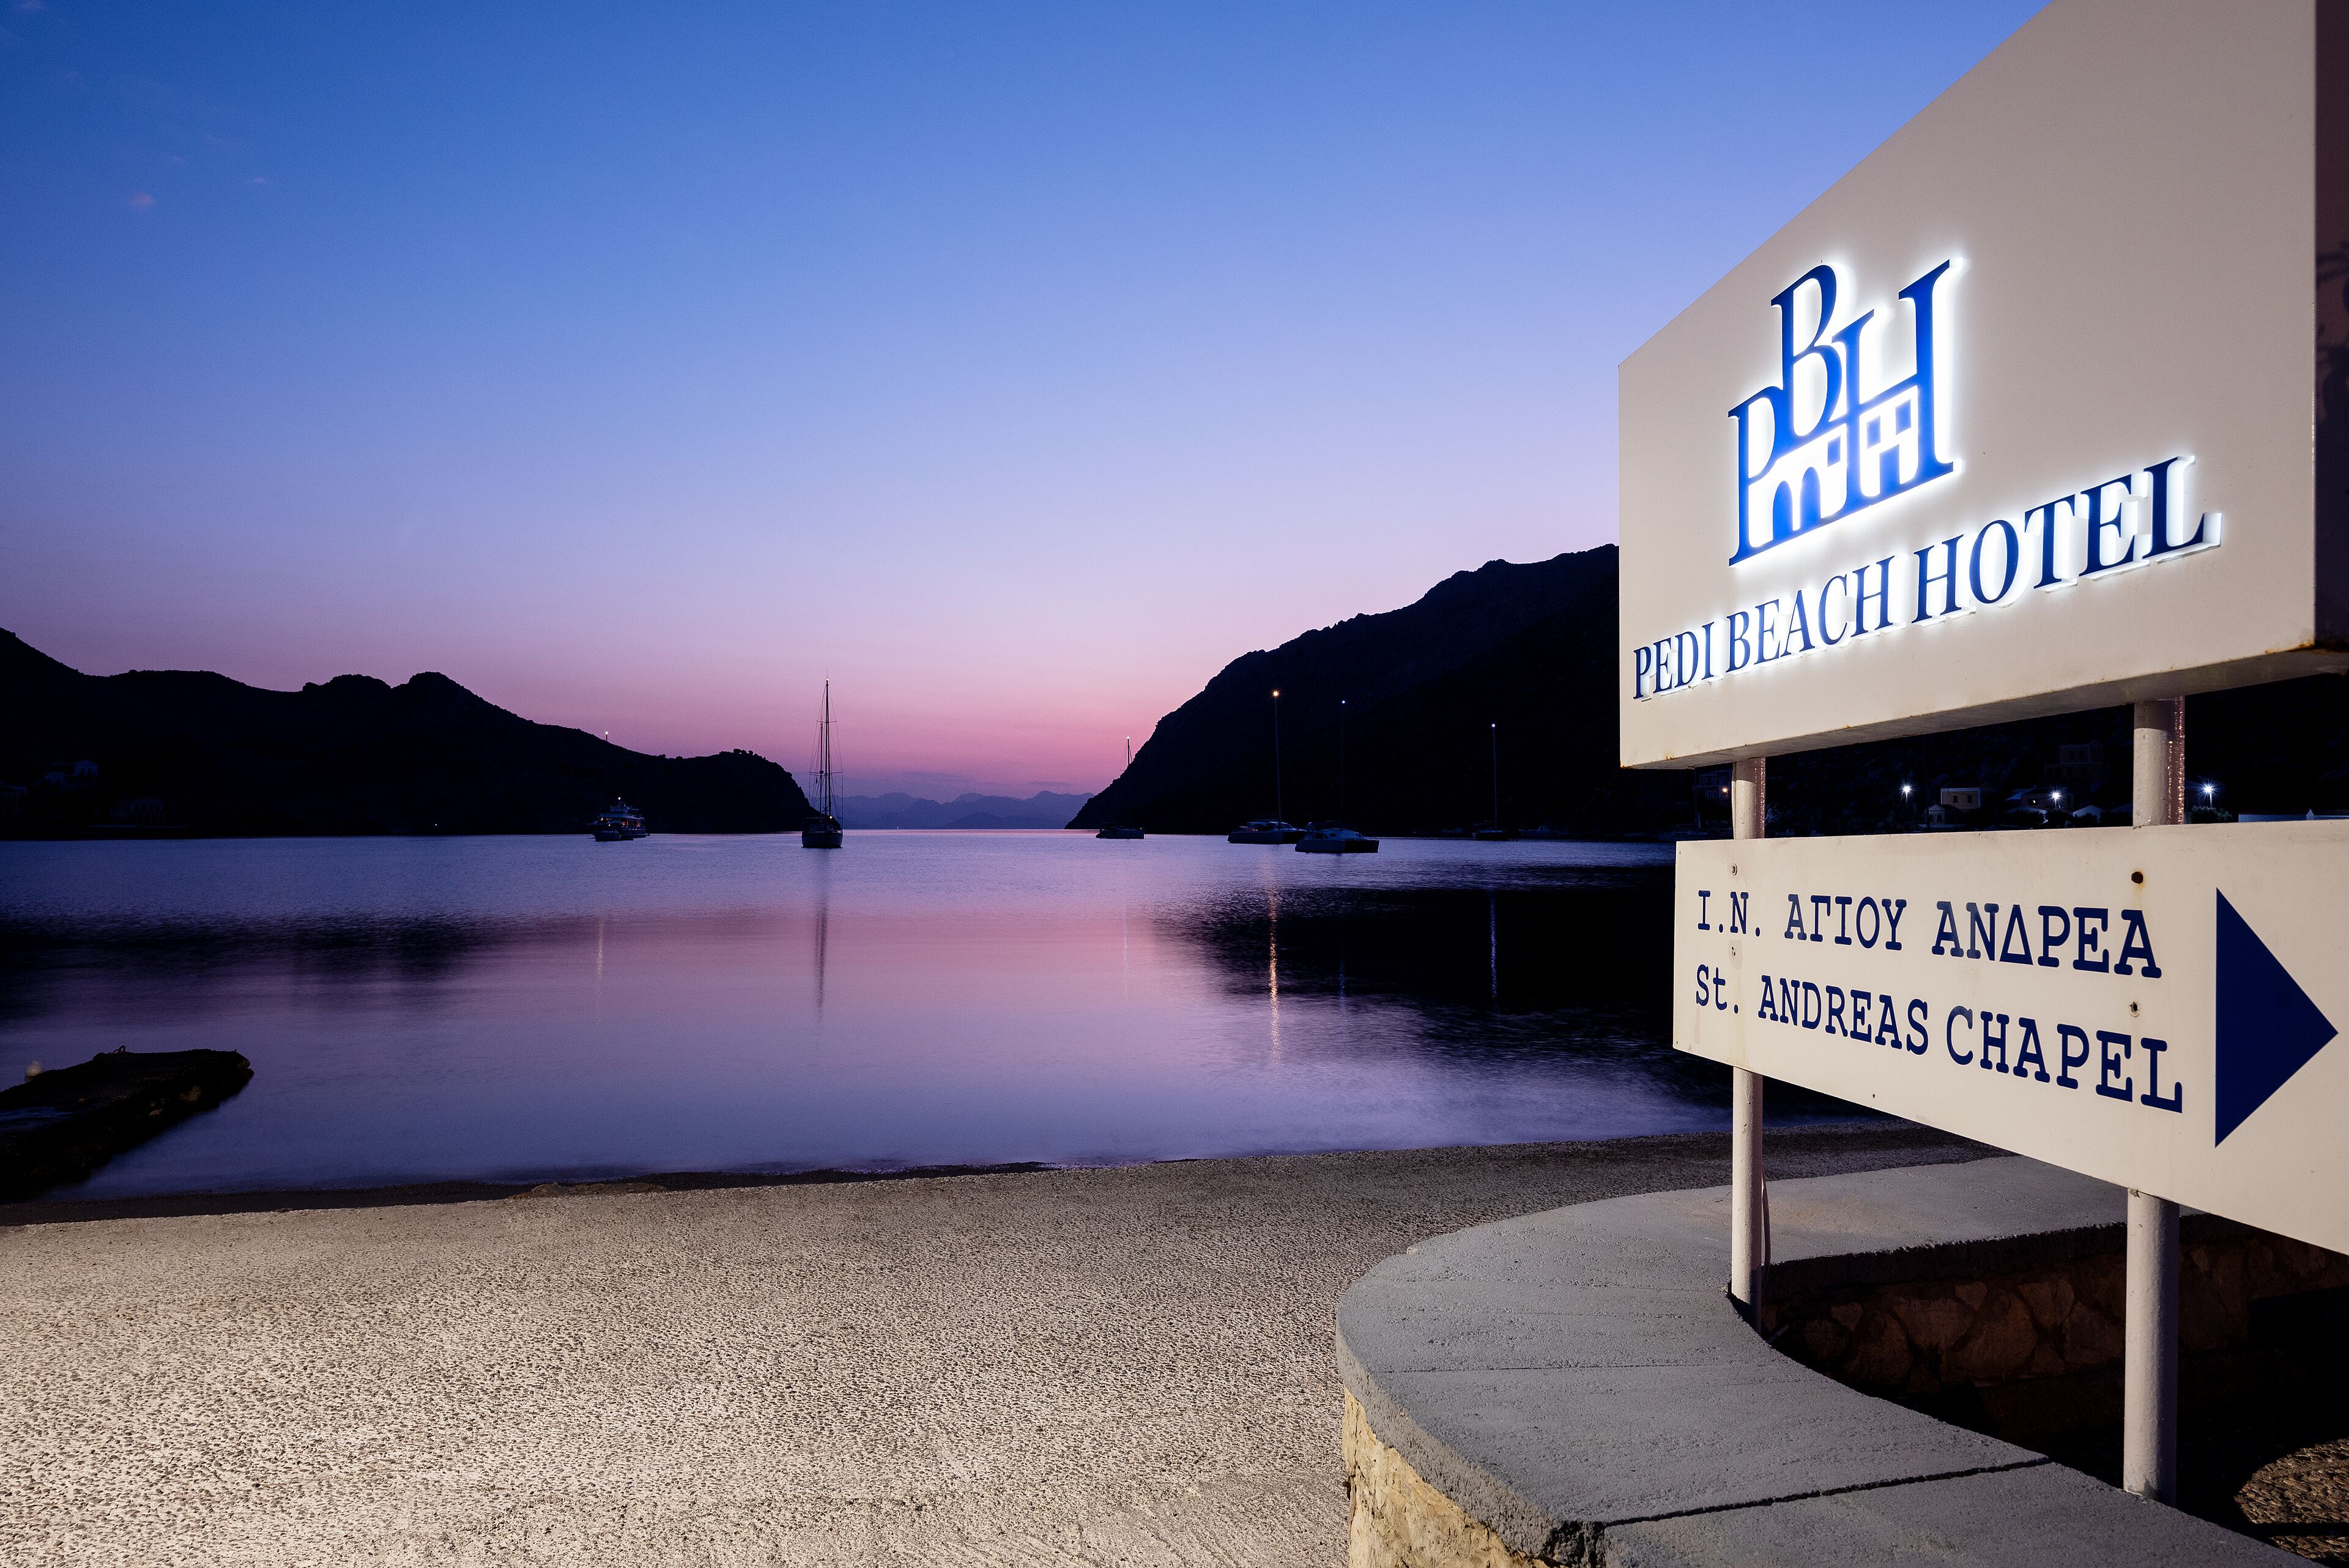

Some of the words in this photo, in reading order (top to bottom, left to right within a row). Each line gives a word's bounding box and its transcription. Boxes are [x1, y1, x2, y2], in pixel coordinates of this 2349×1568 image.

[1633, 621, 1715, 700] PEDI
[1726, 554, 1896, 674] BEACH
[1910, 456, 2206, 624] HOTEL
[1784, 893, 1907, 951] ΑΓΙΟΥ
[1931, 900, 2162, 978] ΑΝΔΡΕΑ
[1696, 964, 1740, 1014] St.
[1758, 975, 1929, 1055] ANDREAS
[1946, 1005, 2183, 1113] CHAPEL
